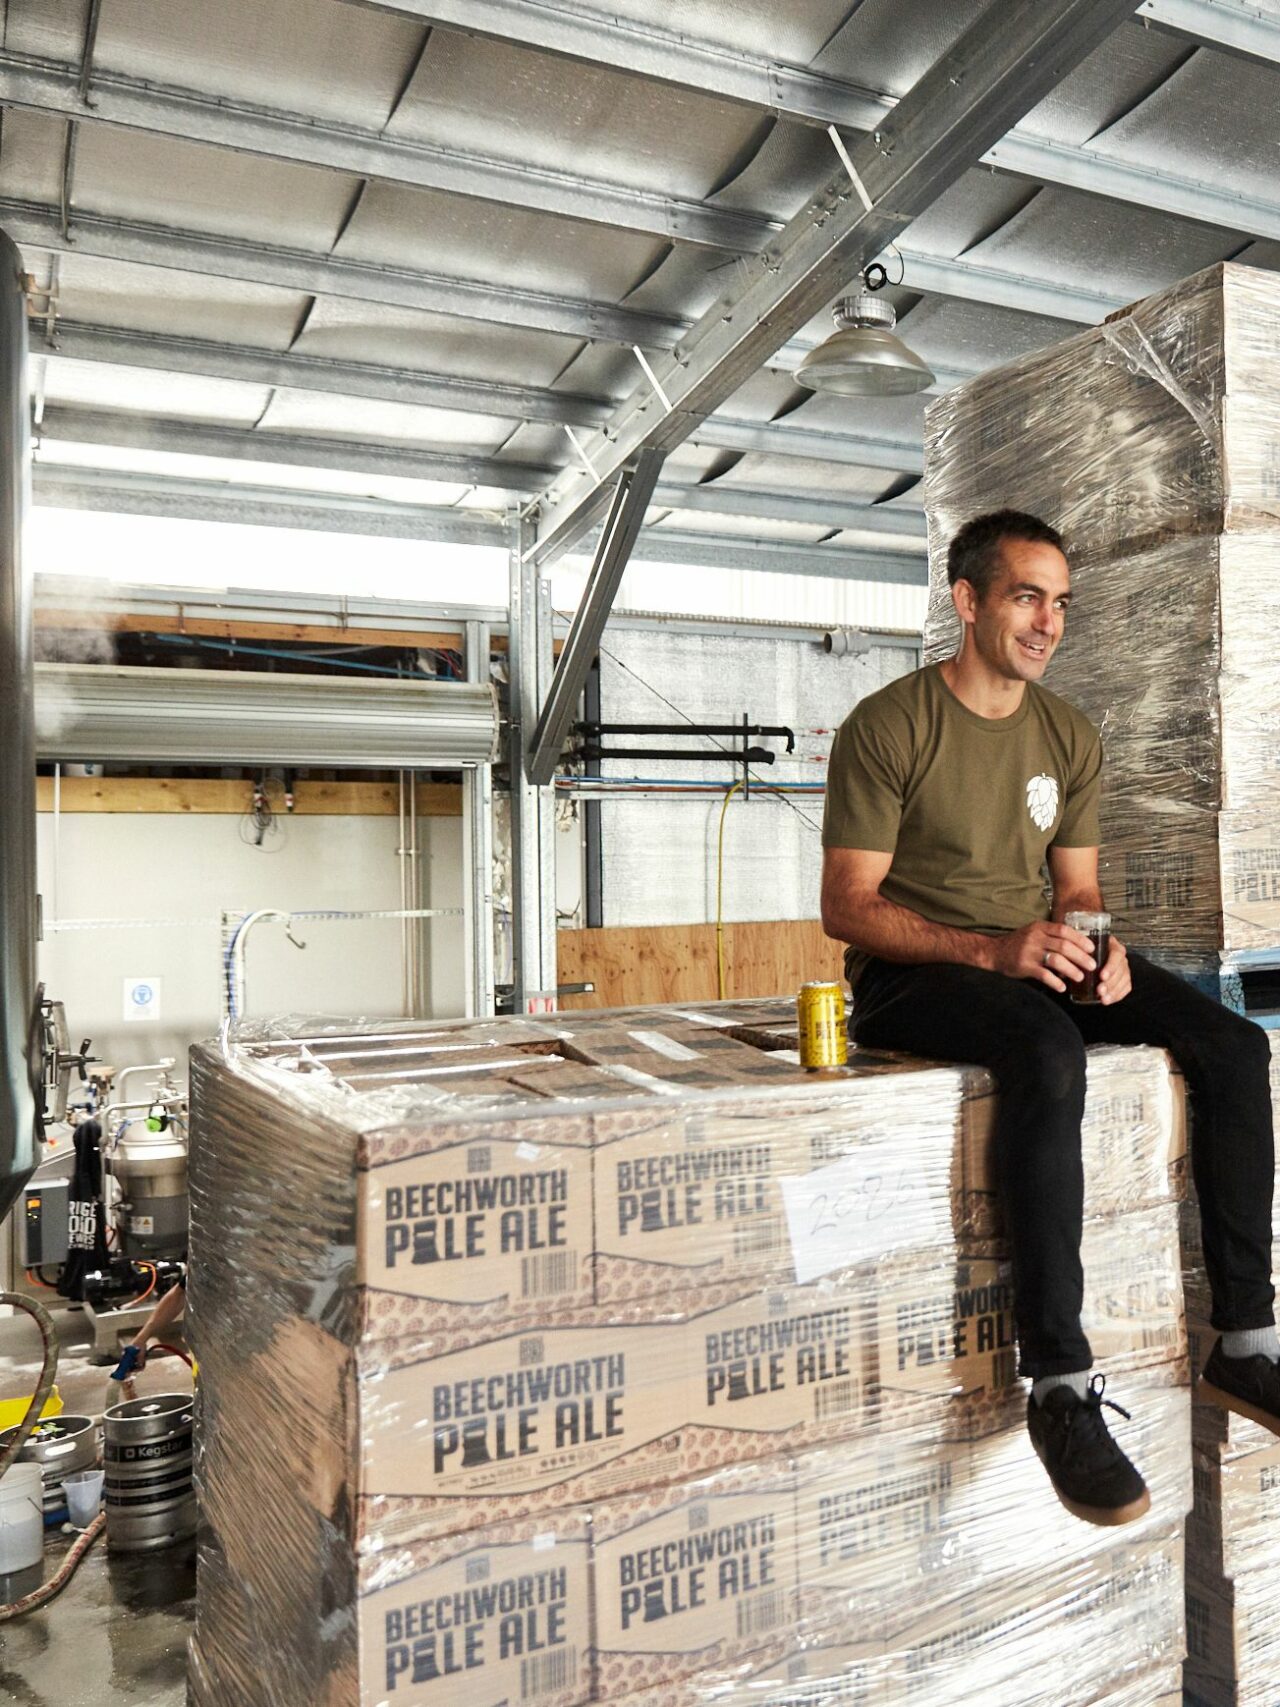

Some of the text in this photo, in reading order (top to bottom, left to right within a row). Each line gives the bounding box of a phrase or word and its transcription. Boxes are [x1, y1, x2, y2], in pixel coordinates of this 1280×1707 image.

[386, 1170, 567, 1221] BEECHWORTH
[617, 1146, 770, 1193] BEECHWORTH
[386, 1204, 566, 1267] PALE ALE
[618, 1176, 770, 1235] PALE ALE
[706, 1308, 849, 1365] BEECHWORTH
[977, 1312, 1012, 1353] AL
[434, 1354, 624, 1423] BEECHWORTH
[707, 1337, 849, 1405] PALE ALE
[434, 1406, 541, 1473] PALE
[558, 1390, 624, 1447] ALE
[620, 1514, 774, 1588] BEECHWORTH
[386, 1567, 565, 1645] BEECHWORTH
[621, 1546, 774, 1630] PALE ALE
[386, 1602, 565, 1691] PALE ALE
